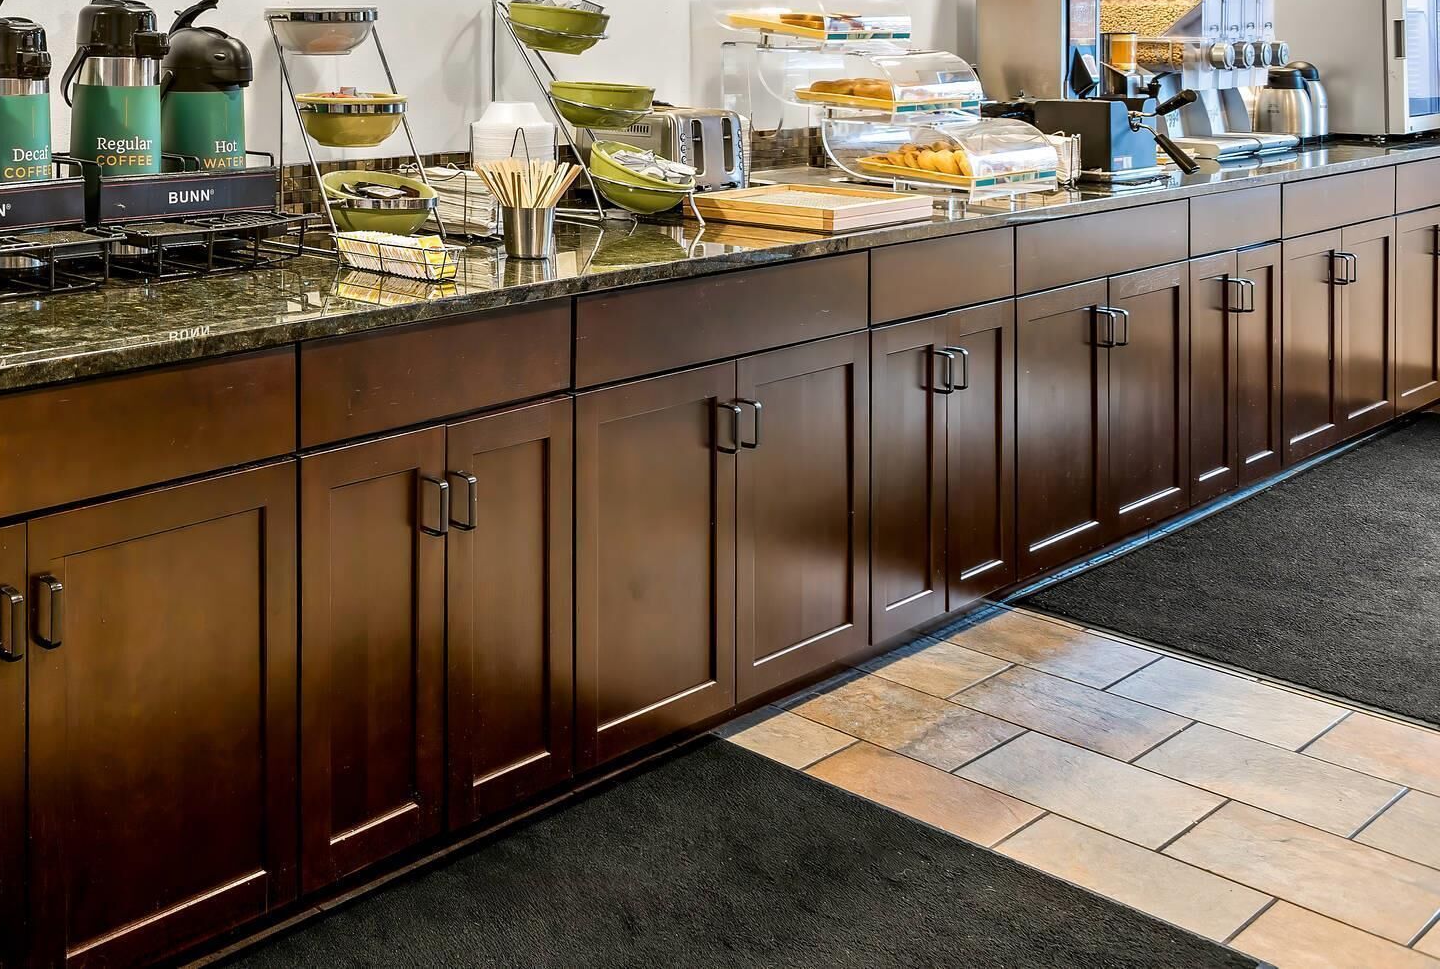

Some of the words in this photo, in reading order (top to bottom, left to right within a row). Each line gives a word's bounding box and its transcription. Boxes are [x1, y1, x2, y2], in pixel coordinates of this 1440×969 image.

[96, 136, 153, 154] Regular
[215, 140, 238, 153] Hot
[12, 145, 50, 162] Decaf
[96, 155, 153, 166] COFFEE
[203, 157, 244, 169] WATER
[4, 164, 52, 179] COFFEE
